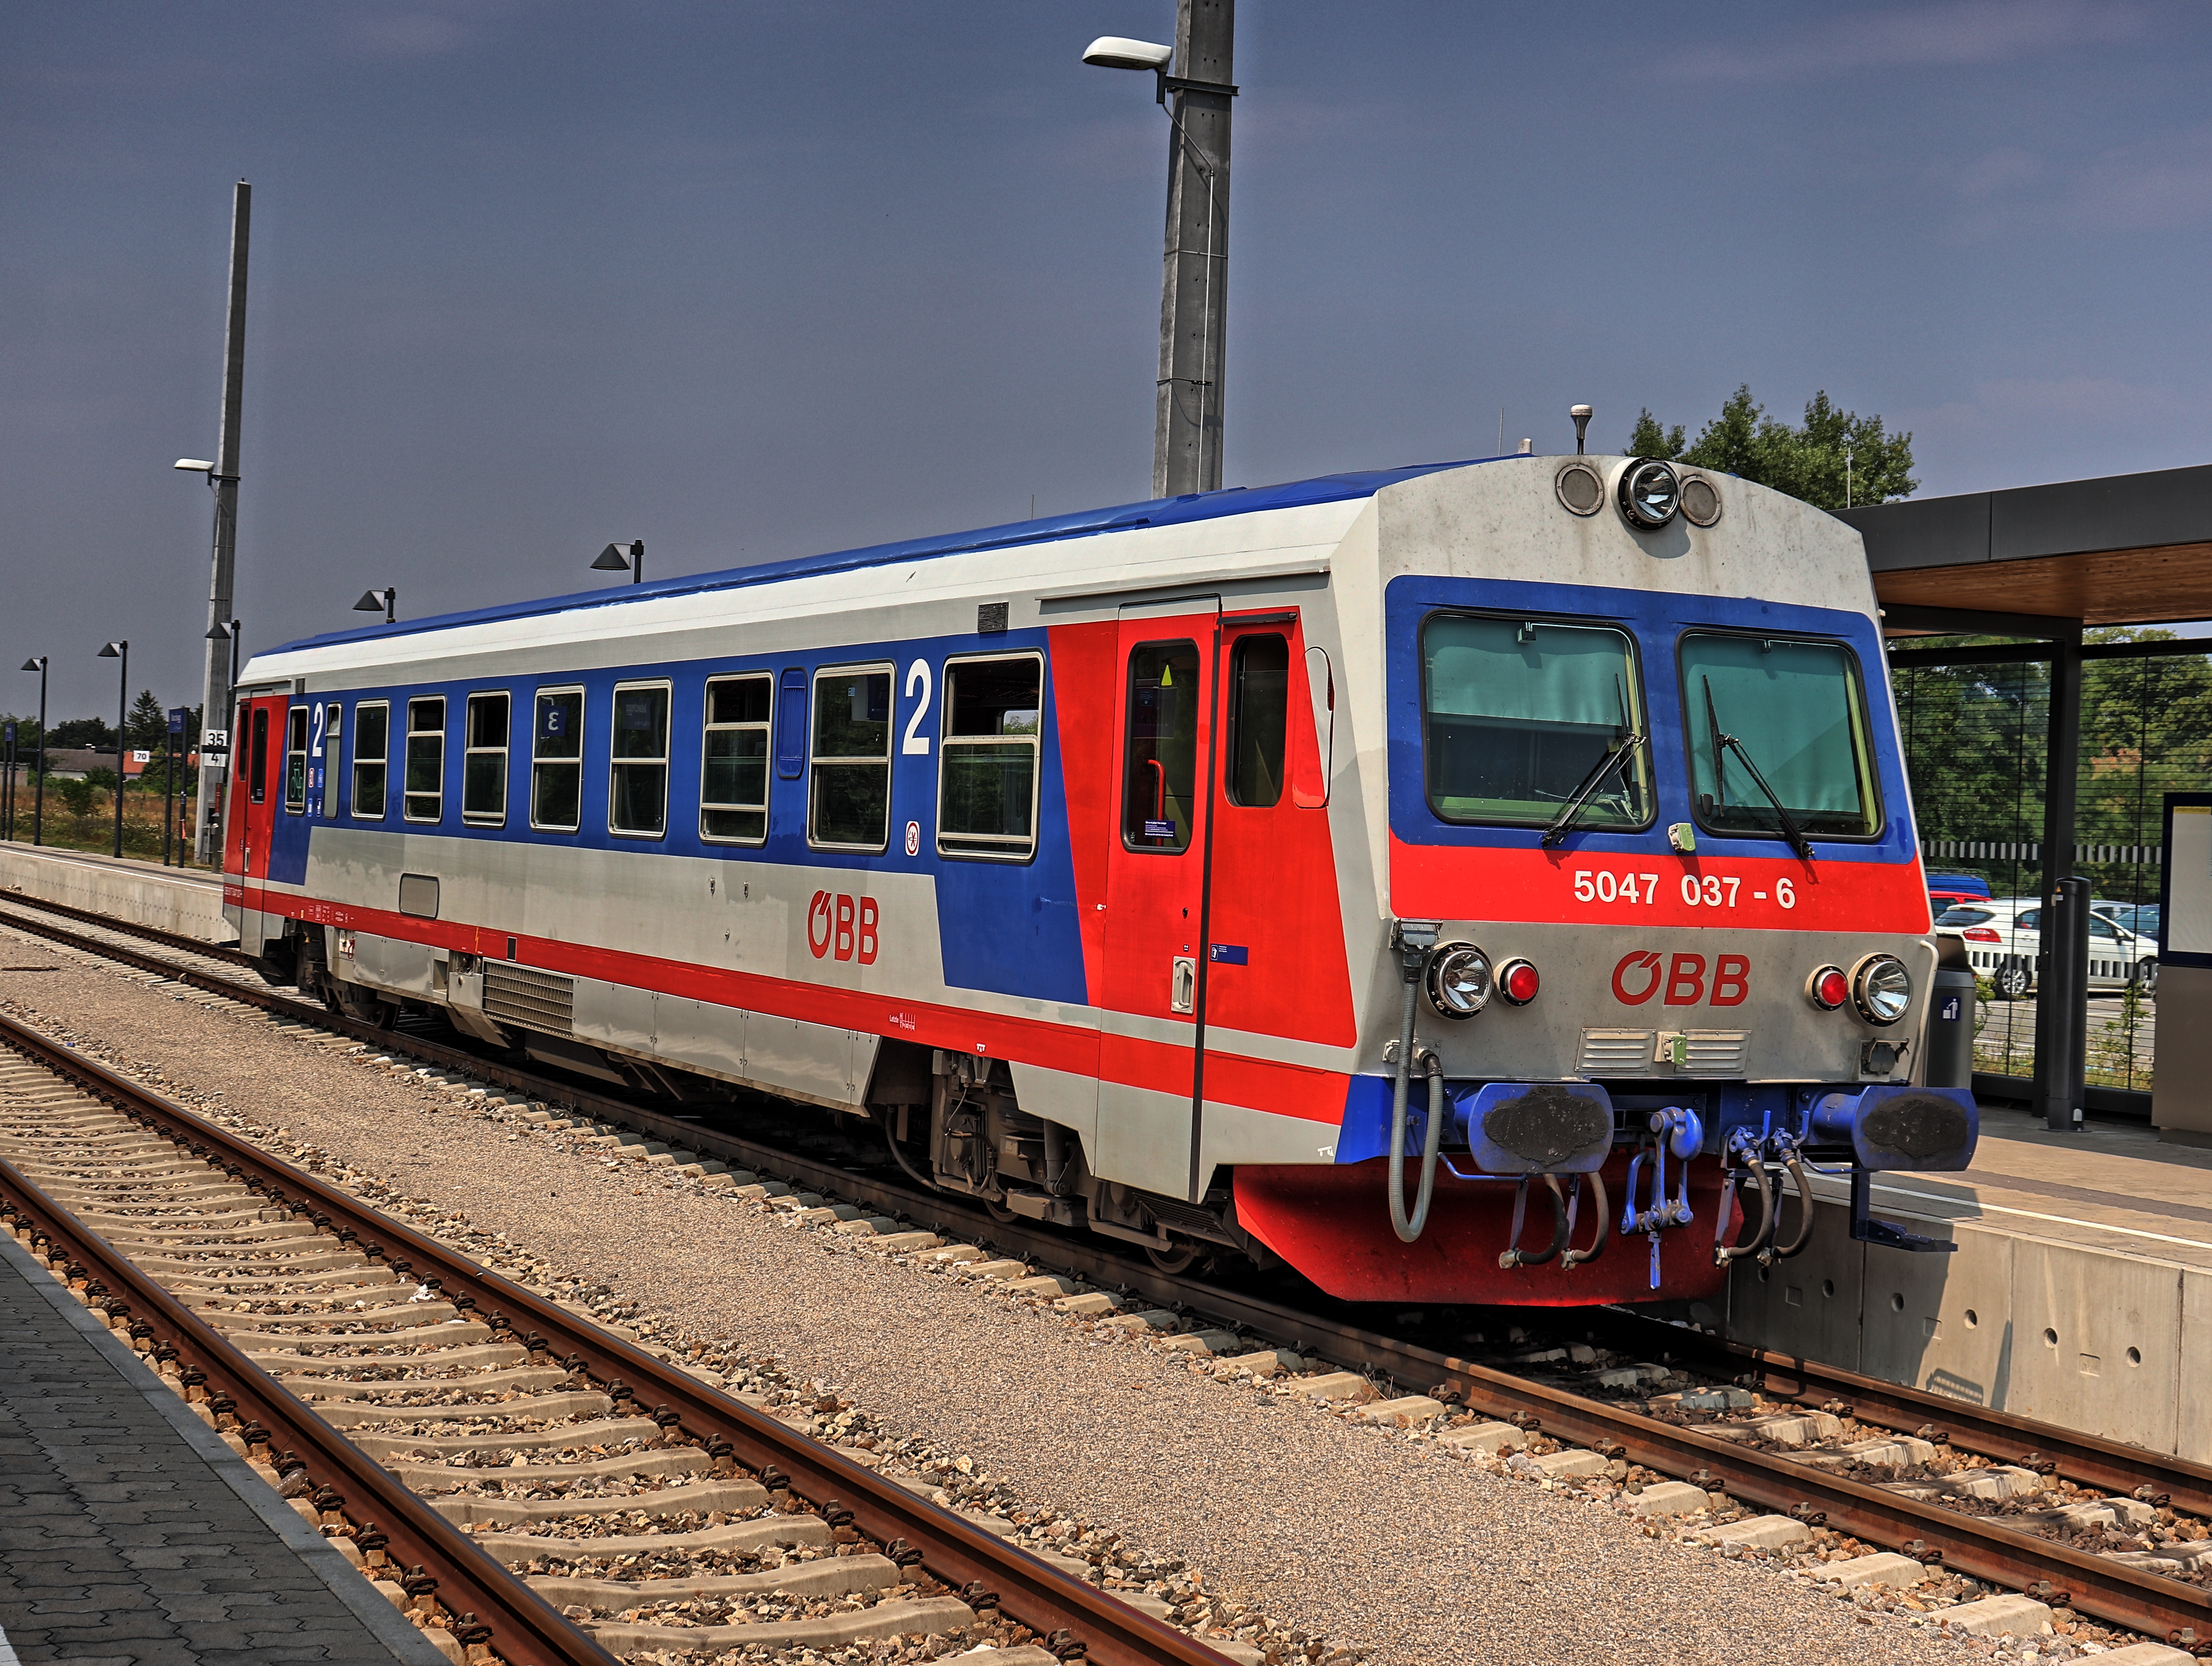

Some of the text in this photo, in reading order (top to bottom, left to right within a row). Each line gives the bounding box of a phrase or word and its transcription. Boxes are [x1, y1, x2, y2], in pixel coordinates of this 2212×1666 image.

[312, 702, 324, 756] 2
[902, 658, 931, 754] 2
[208, 733, 224, 746] 35
[211, 753, 219, 763] 4
[1574, 870, 1659, 904] 5047
[1680, 874, 1741, 907] 037
[807, 889, 879, 966] ÖBB
[1611, 950, 1751, 1007] ÖBB
